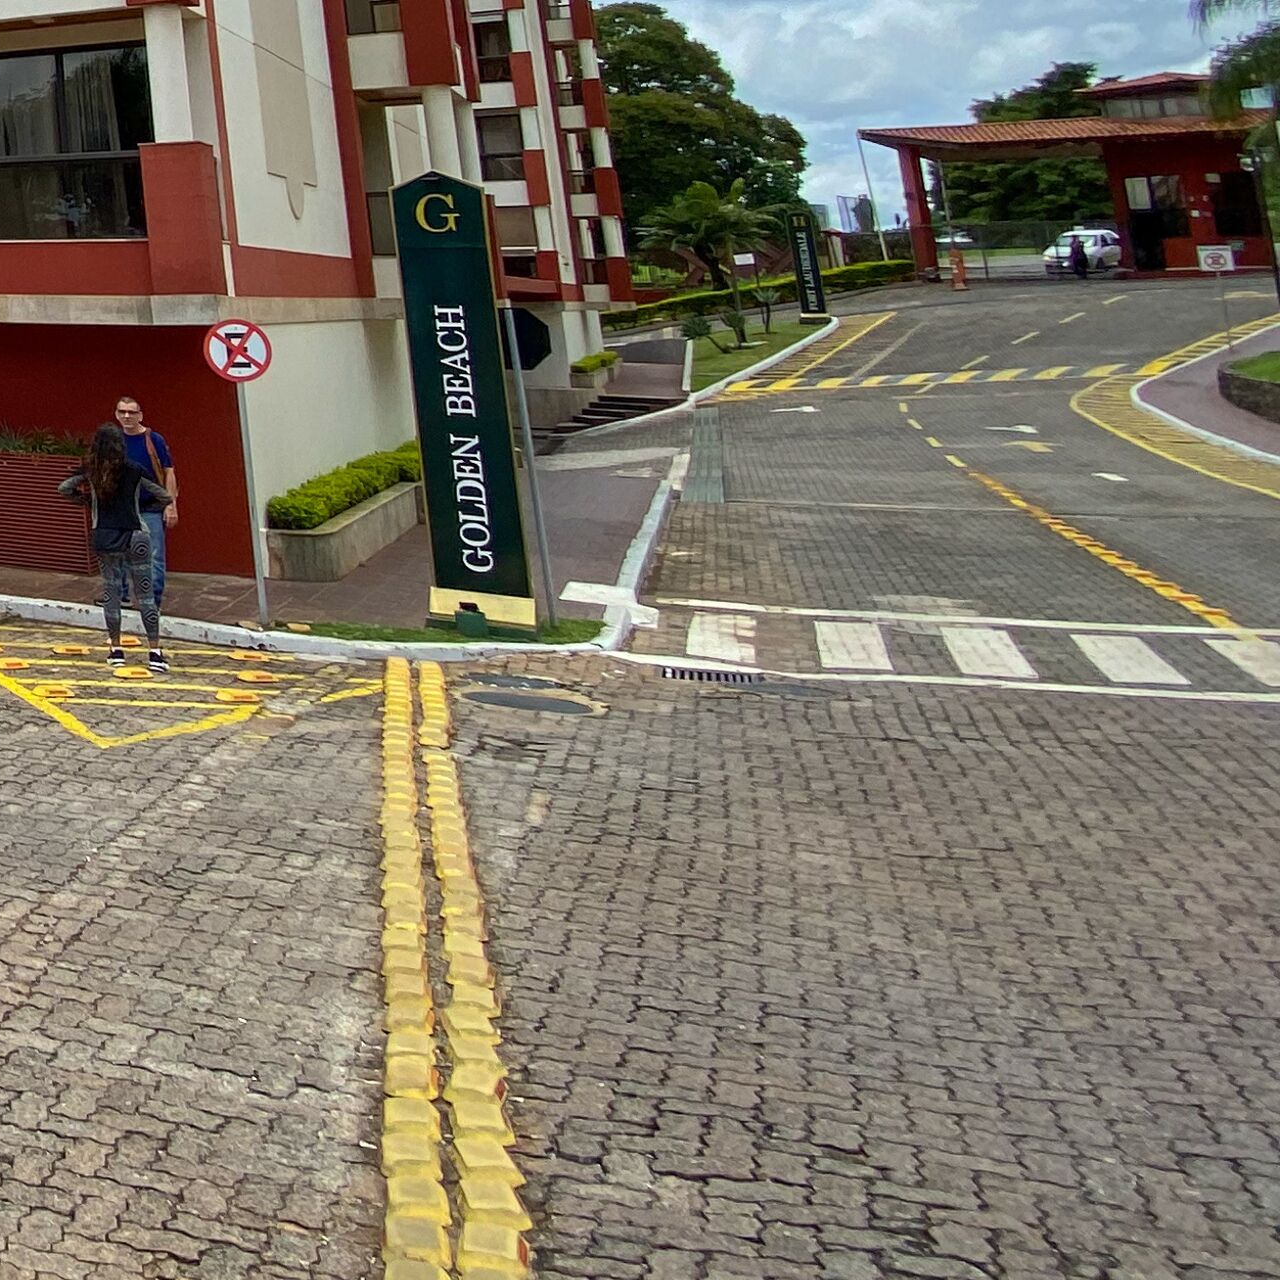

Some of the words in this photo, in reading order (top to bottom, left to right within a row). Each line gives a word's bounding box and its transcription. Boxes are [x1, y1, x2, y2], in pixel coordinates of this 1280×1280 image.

[415, 193, 460, 233] G
[434, 304, 478, 418] BEACH
[448, 433, 494, 574] GOLDEN
